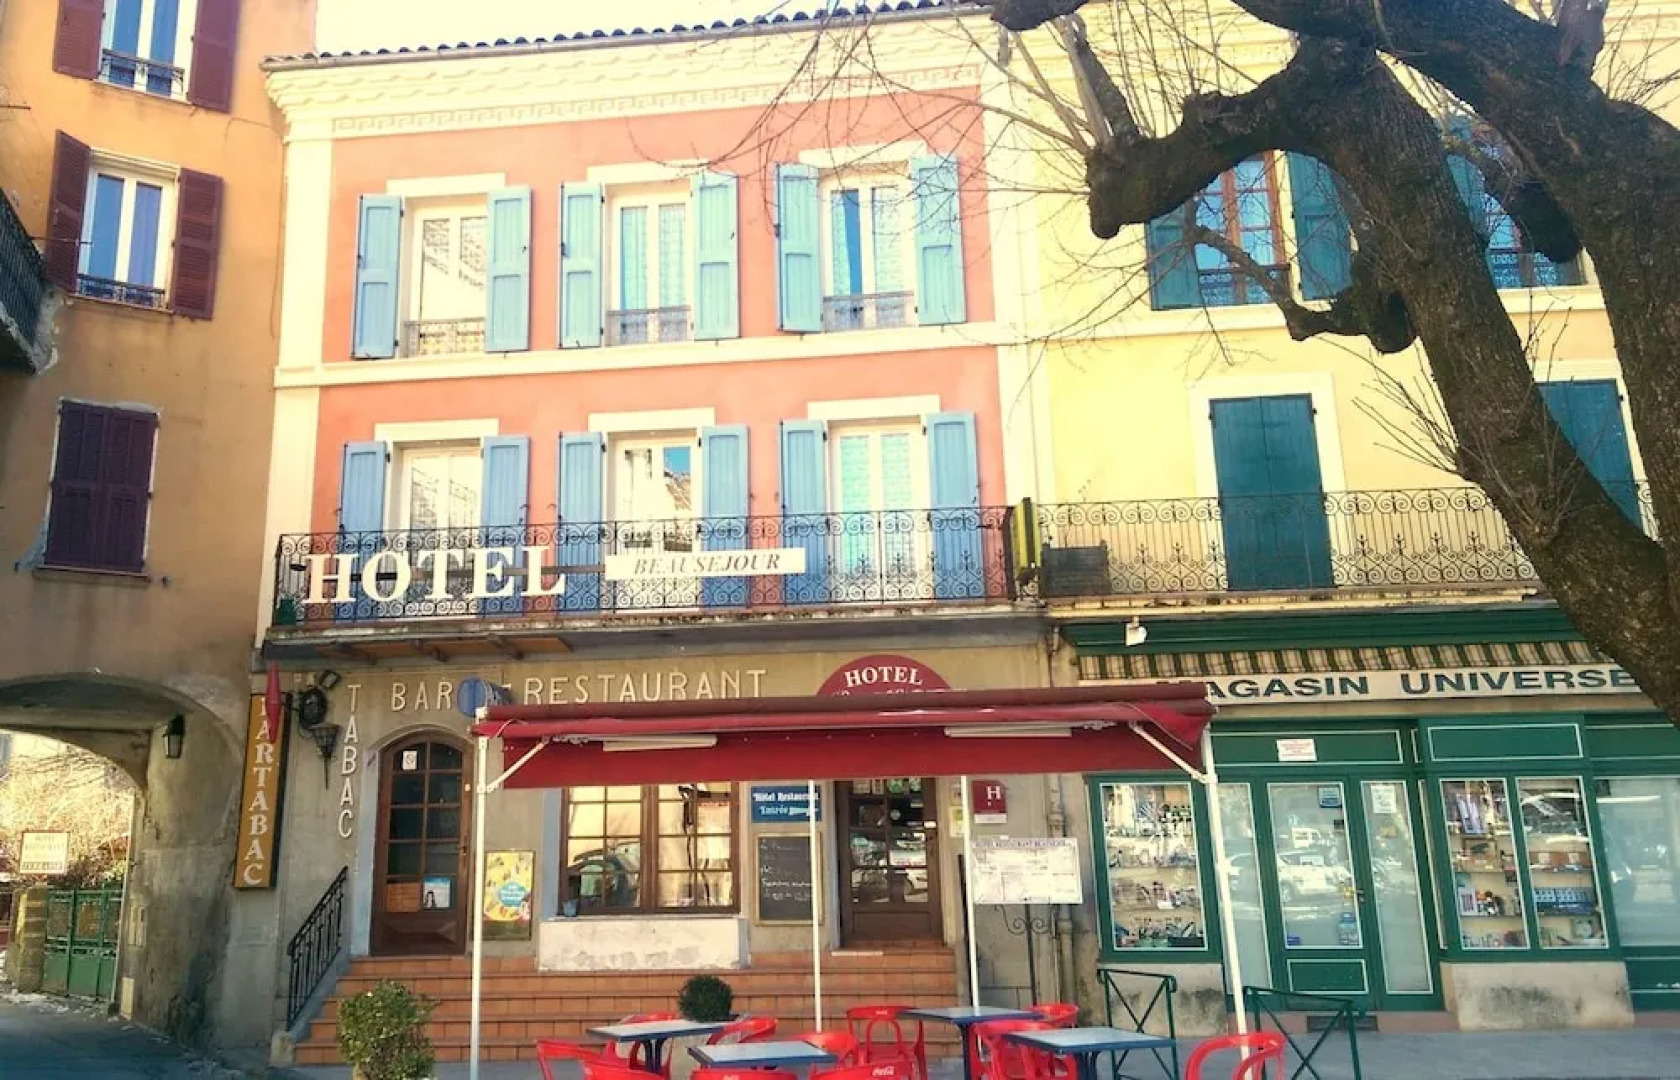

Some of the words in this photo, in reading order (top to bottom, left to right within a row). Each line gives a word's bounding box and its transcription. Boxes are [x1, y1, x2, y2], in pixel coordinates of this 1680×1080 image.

[301, 546, 565, 604] HOTEL
[634, 553, 780, 575] BEAUSEJOUR
[844, 666, 923, 688] HOTEL
[1156, 676, 1369, 698] AGASIN
[391, 681, 453, 712] BAR
[523, 669, 768, 705] RESTAURANT
[338, 684, 361, 838] TABAC
[986, 785, 1001, 800] H
